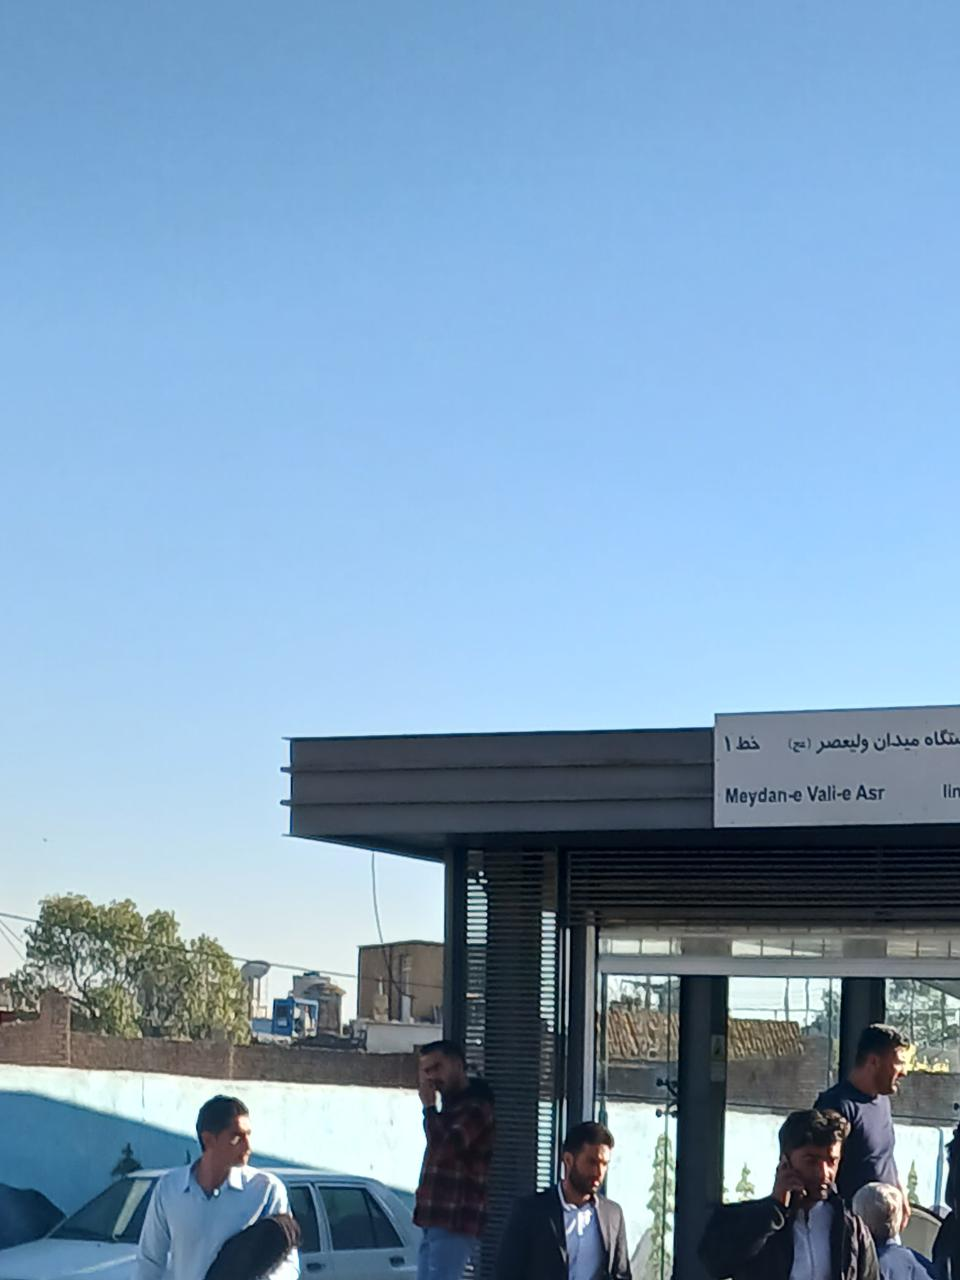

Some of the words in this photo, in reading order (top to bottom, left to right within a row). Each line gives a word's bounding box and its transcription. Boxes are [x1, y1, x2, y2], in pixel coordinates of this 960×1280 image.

[736, 736, 760, 750] خط
[816, 734, 868, 754] ولیعصر
[874, 733, 919, 751] میدان
[726, 787, 802, 807] Meydan-e
[807, 785, 851, 801] Vali-e
[856, 785, 885, 800] Asr
